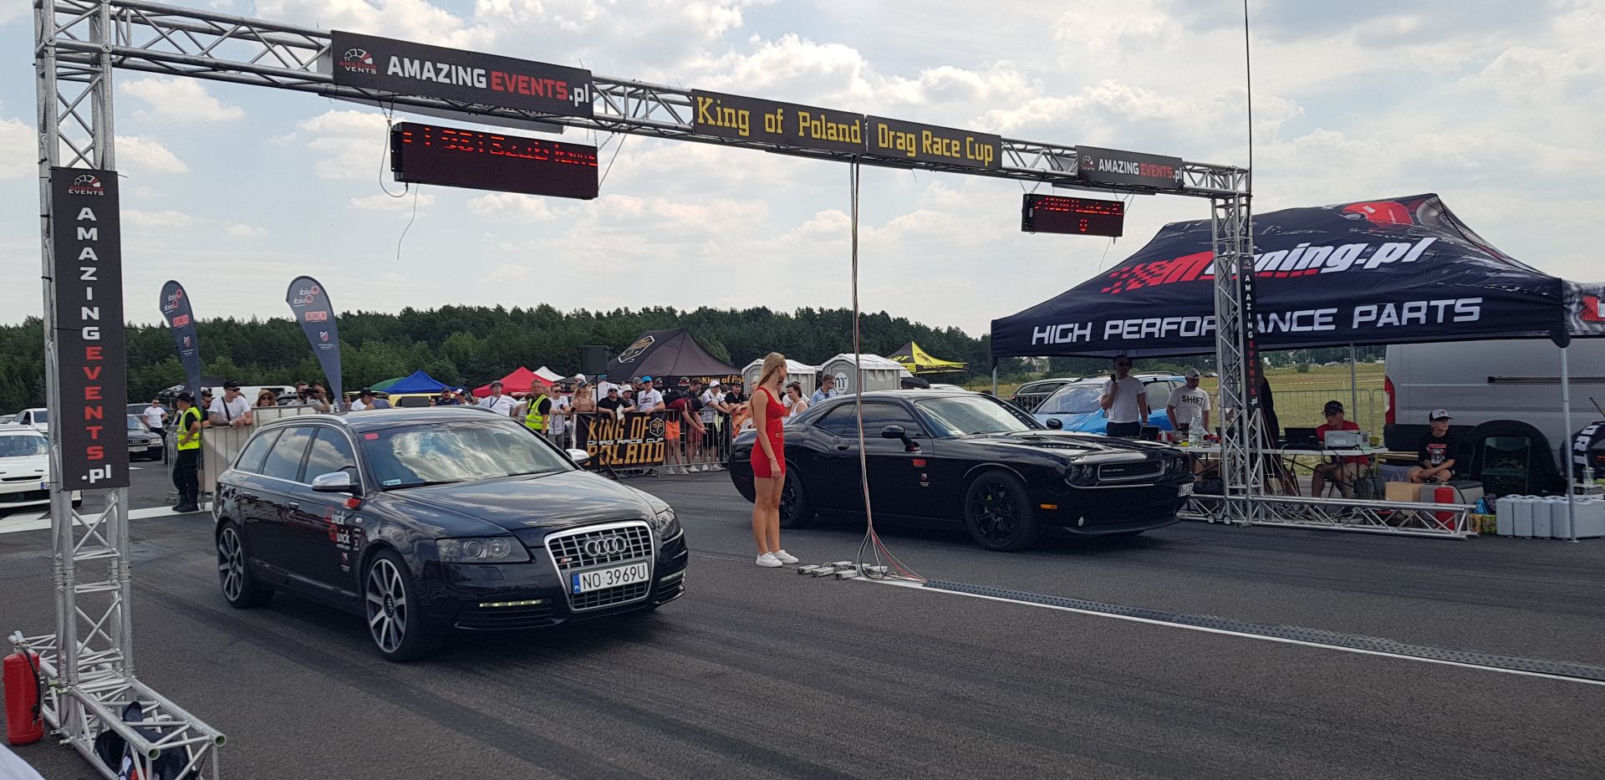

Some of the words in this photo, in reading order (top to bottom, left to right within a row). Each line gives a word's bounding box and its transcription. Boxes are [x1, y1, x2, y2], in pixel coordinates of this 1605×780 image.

[387, 55, 487, 89] AMAZING
[697, 96, 750, 137] King
[764, 108, 784, 134] of
[797, 111, 862, 144] Poland
[877, 123, 917, 158] Drag
[922, 130, 962, 158] Race
[966, 136, 994, 167] Cup
[1098, 158, 1140, 176] AMAZING
[1031, 321, 1093, 346] HIGH
[1352, 297, 1483, 329] PARTS
[587, 416, 626, 440] KING
[630, 415, 652, 440] OF
[582, 572, 601, 590] NO
[606, 564, 646, 586] 3969U
